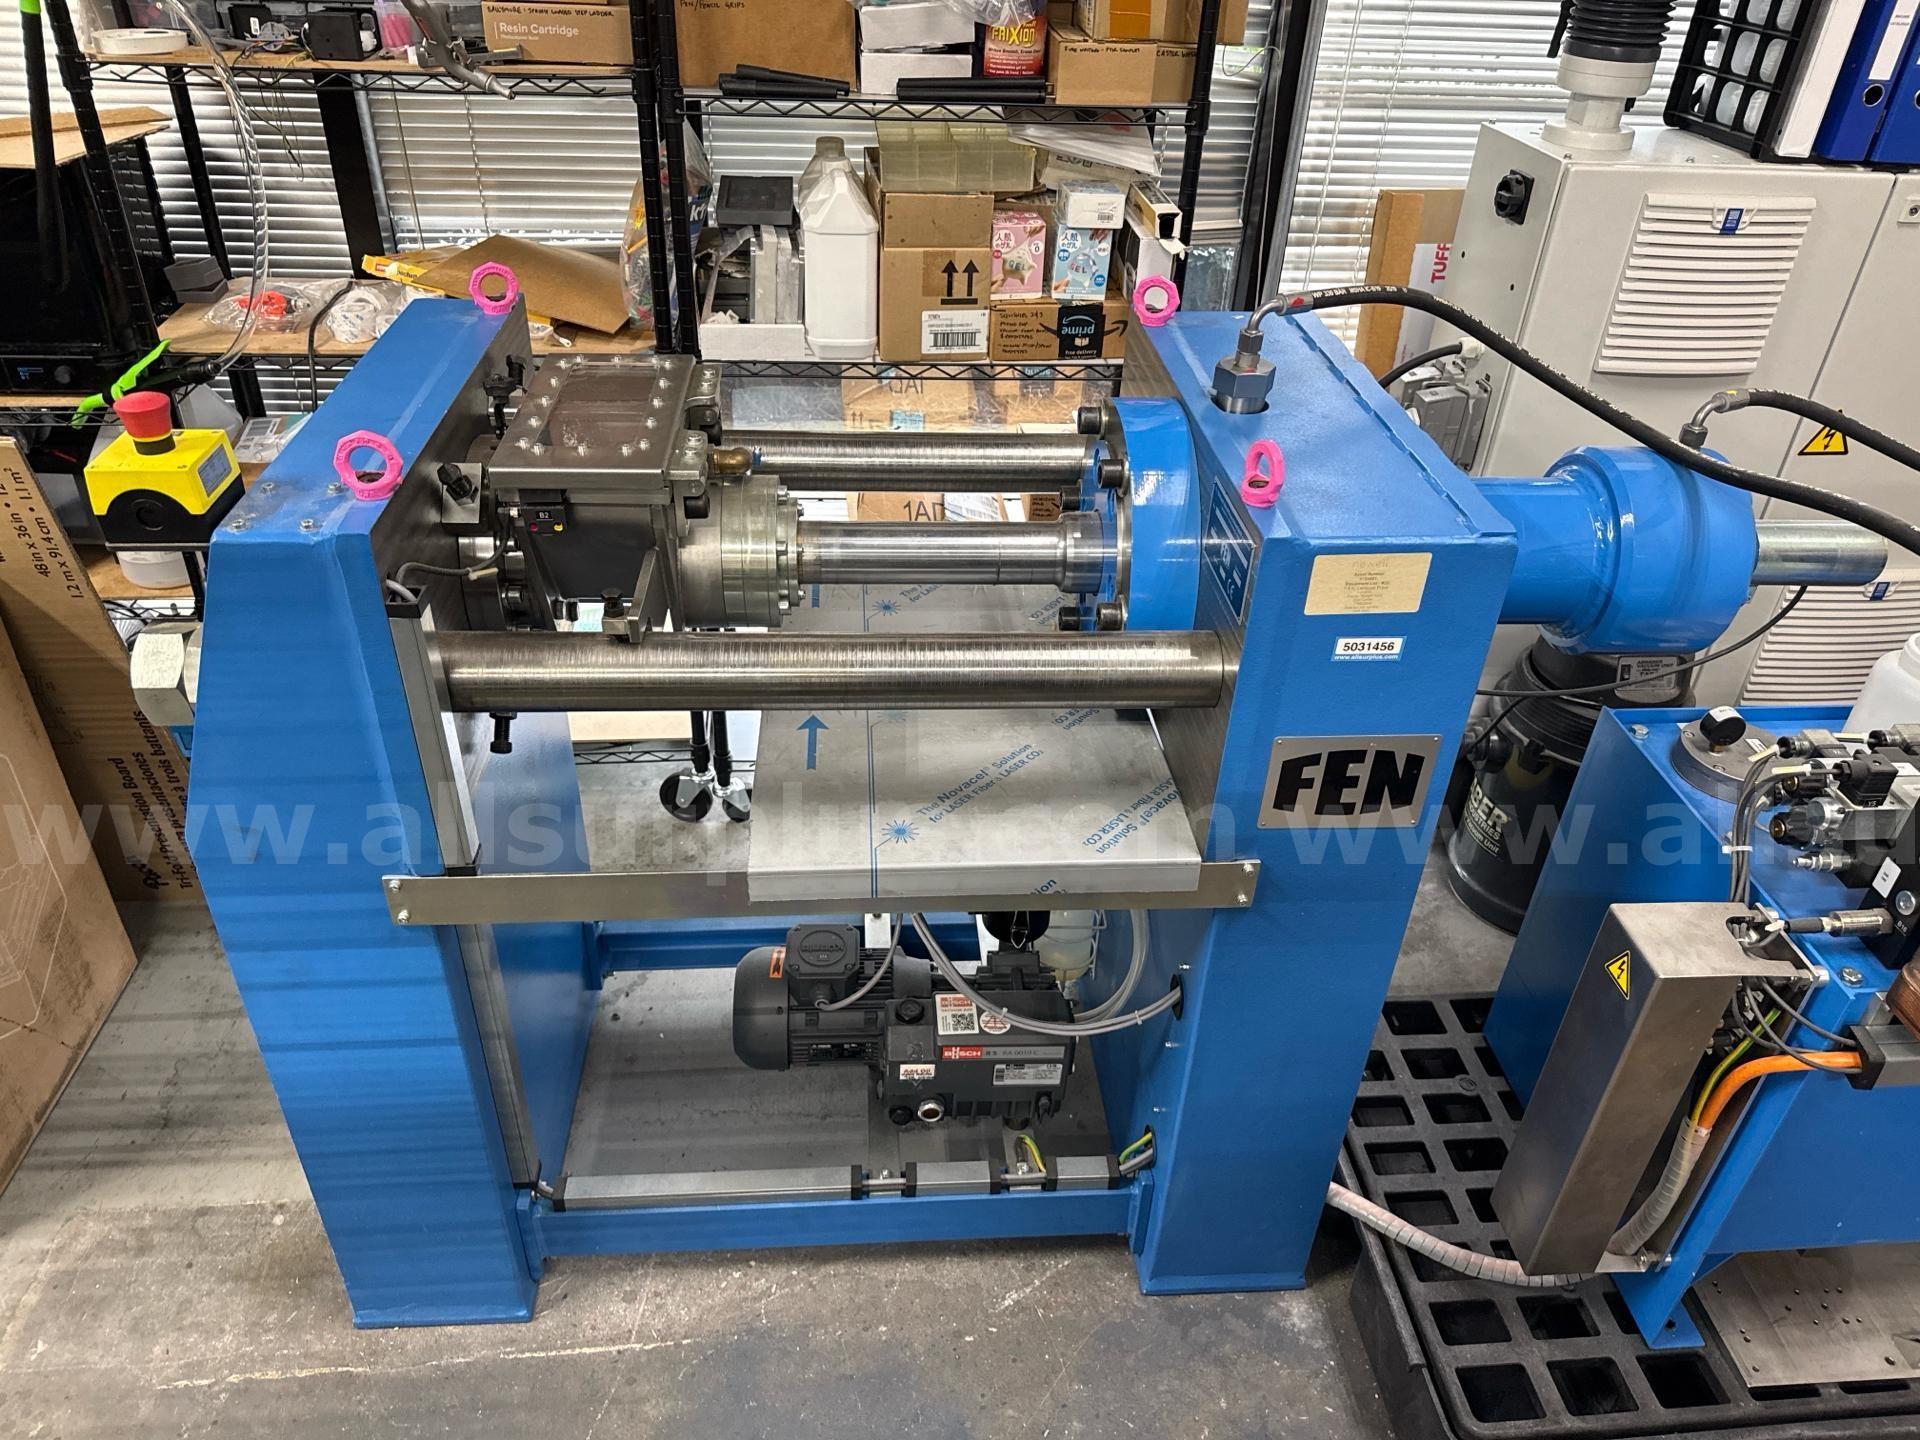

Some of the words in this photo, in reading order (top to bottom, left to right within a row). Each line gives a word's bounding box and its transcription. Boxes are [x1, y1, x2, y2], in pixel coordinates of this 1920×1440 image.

[500, 23, 528, 33] Resin
[530, 23, 579, 38] Cartridge
[1009, 260, 1027, 271] GEL
[1061, 324, 1095, 336] prime
[1343, 642, 1395, 652] 5031456
[158, 759, 181, 785] trois
[917, 801, 940, 817] The
[992, 743, 1033, 769] Solution
[1272, 750, 1425, 815] FEN
[132, 751, 180, 829] presentaciones
[929, 812, 945, 824] for
[946, 793, 973, 814] LASER
[972, 779, 996, 796] Fiber
[1000, 758, 1028, 778] LASER
[107, 757, 138, 789] Board
[131, 791, 170, 857] Presentation
[1131, 794, 1153, 811] Fiber
[1100, 813, 1129, 834] LASER
[1096, 823, 1138, 853] Solution
[1484, 839, 1500, 854] Unit
[943, 1047, 982, 1060] BUSCH
